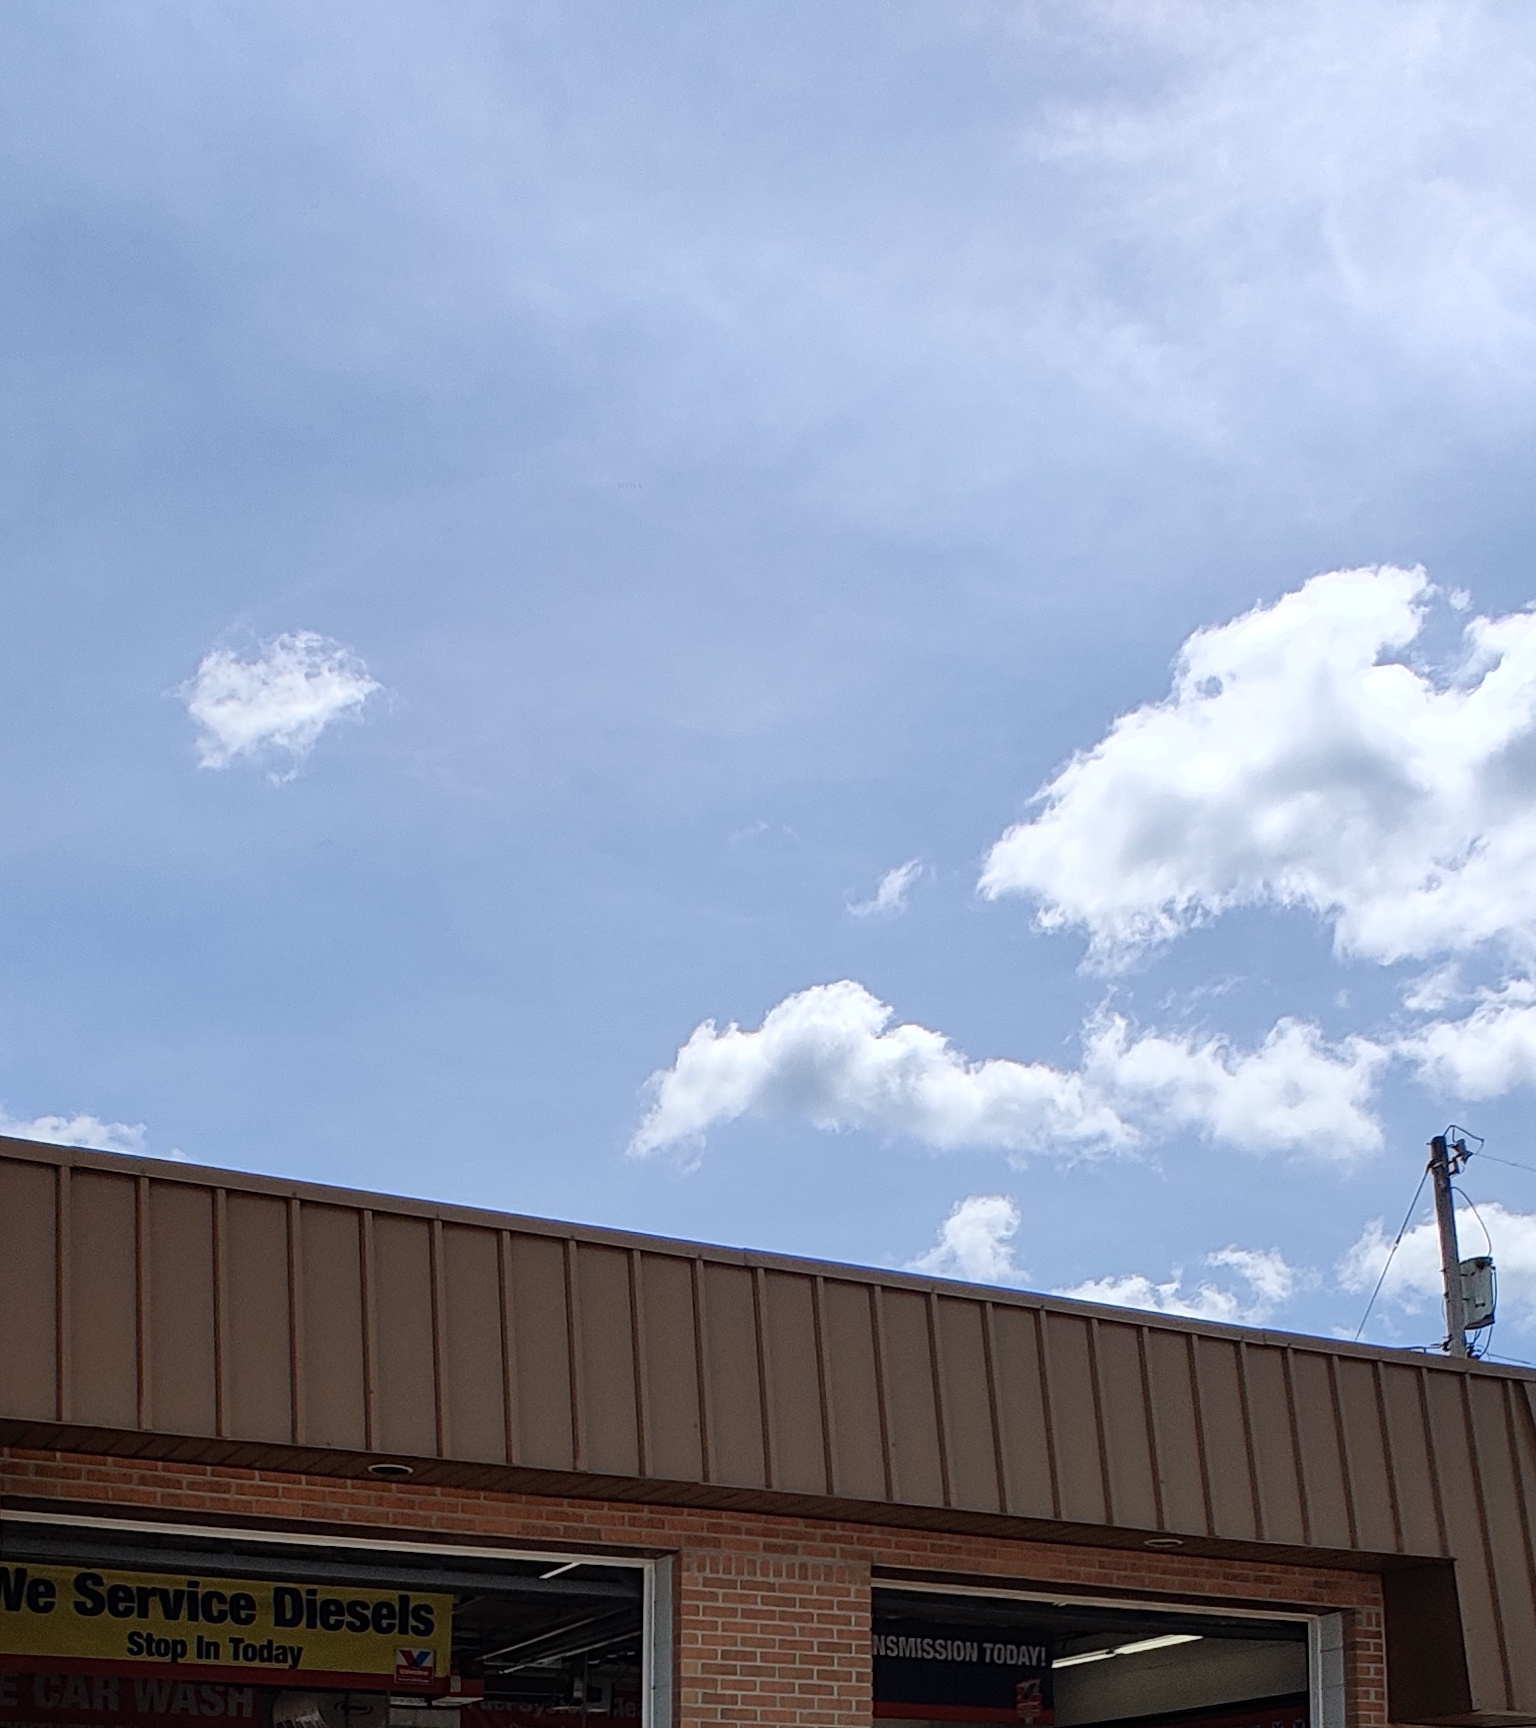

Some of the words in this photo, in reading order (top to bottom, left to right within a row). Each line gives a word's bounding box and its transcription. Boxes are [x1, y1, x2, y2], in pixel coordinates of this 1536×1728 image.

[74, 1572, 257, 1626] Service
[273, 1586, 435, 1637] Diesels
[127, 1631, 188, 1663] Stop
[196, 1635, 221, 1661] In
[229, 1637, 303, 1670] Today
[982, 1642, 1047, 1668] TODAY!
[34, 1672, 121, 1713] CAR
[133, 1676, 253, 1719] WASH
